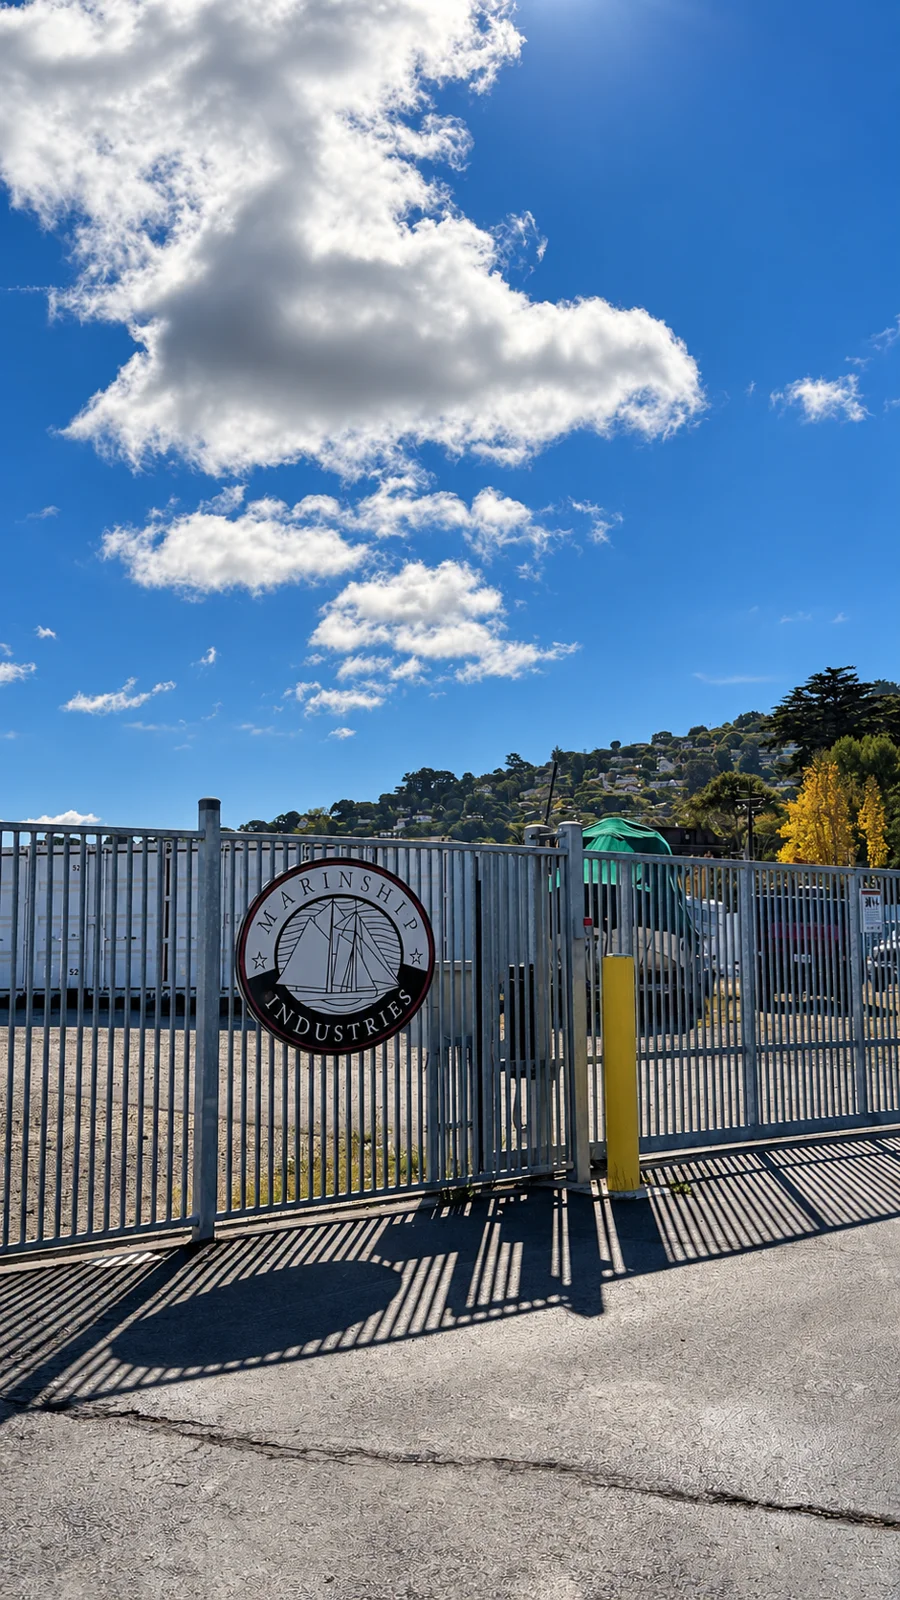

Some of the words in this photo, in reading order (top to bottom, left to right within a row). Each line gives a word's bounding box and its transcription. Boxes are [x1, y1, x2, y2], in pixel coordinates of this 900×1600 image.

[257, 871, 418, 935] MARINSHIP
[69, 968, 79, 976] 52
[265, 989, 412, 1042] INDUSTRIES
